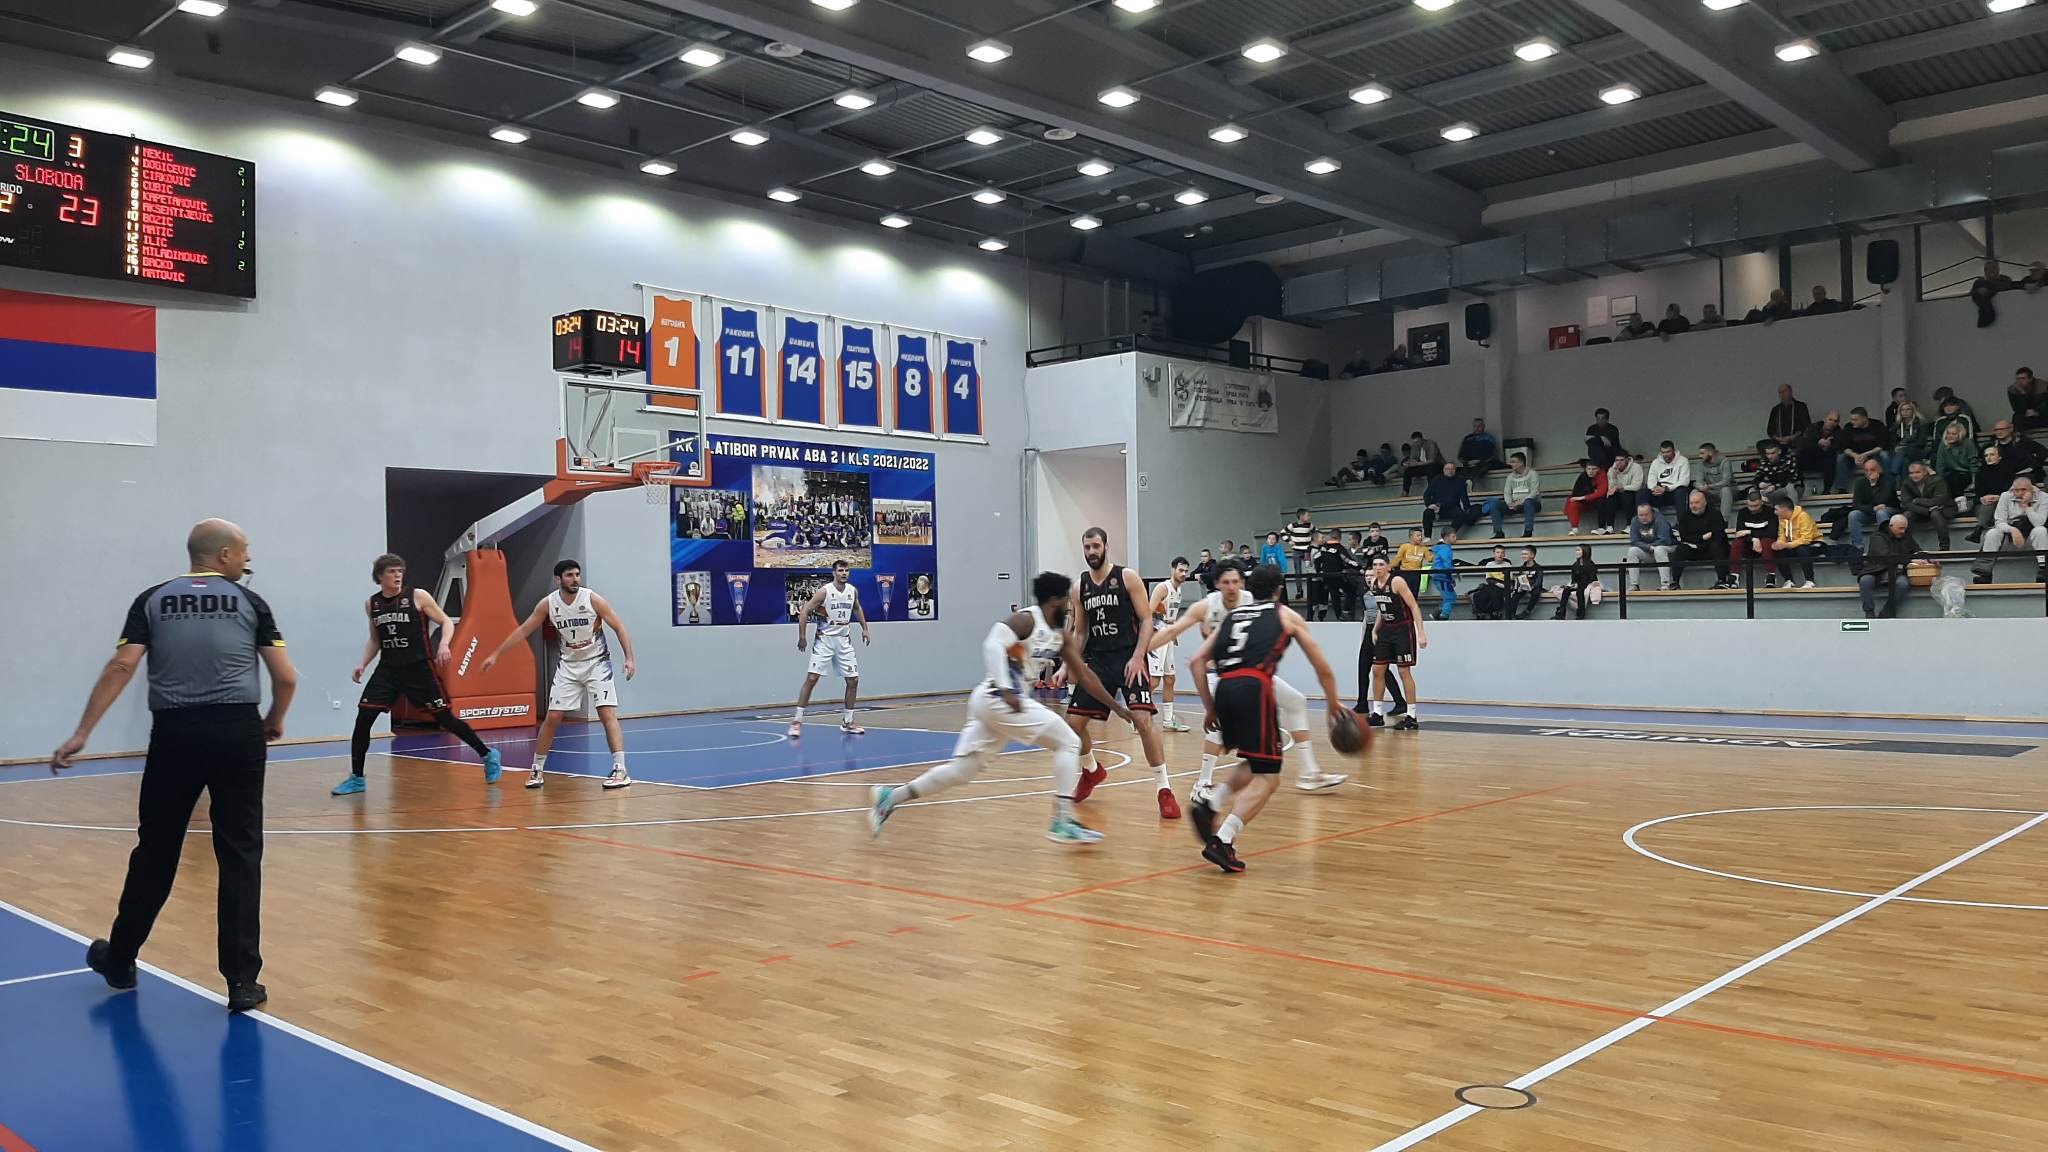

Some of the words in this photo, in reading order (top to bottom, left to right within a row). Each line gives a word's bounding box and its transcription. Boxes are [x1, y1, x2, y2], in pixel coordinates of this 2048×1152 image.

[68, 136, 82, 158] 3
[15, 163, 84, 191] SLOBODA
[59, 194, 98, 226] 23
[143, 234, 168, 248] ILIC
[555, 316, 581, 336] 03:24
[597, 315, 639, 336] 03:24
[619, 339, 640, 364] 14
[664, 336, 680, 367] 1
[726, 344, 755, 377] 11
[787, 353, 817, 385] 14
[845, 360, 874, 390] 15
[904, 368, 922, 397] 8
[953, 374, 970, 400] 4
[676, 438, 694, 453] KK
[705, 440, 757, 458] LATIBOR
[761, 444, 800, 461] PRVAK
[804, 448, 828, 463] ABA
[831, 450, 839, 464] 2
[848, 452, 870, 466] KLS
[873, 454, 929, 471] 2021/2022
[160, 594, 239, 614] ARDU
[838, 610, 847, 619] 24
[386, 624, 397, 635] 12
[570, 629, 577, 640] 7
[1091, 621, 1119, 637] mts
[1227, 620, 1253, 653] 5
[383, 637, 409, 649] mts
[457, 636, 479, 677] EASYPLAY
[1404, 653, 1412, 662] 10
[603, 690, 609, 700] 7
[1140, 691, 1151, 703] 15
[1531, 729, 1843, 747] ADMIRAL
